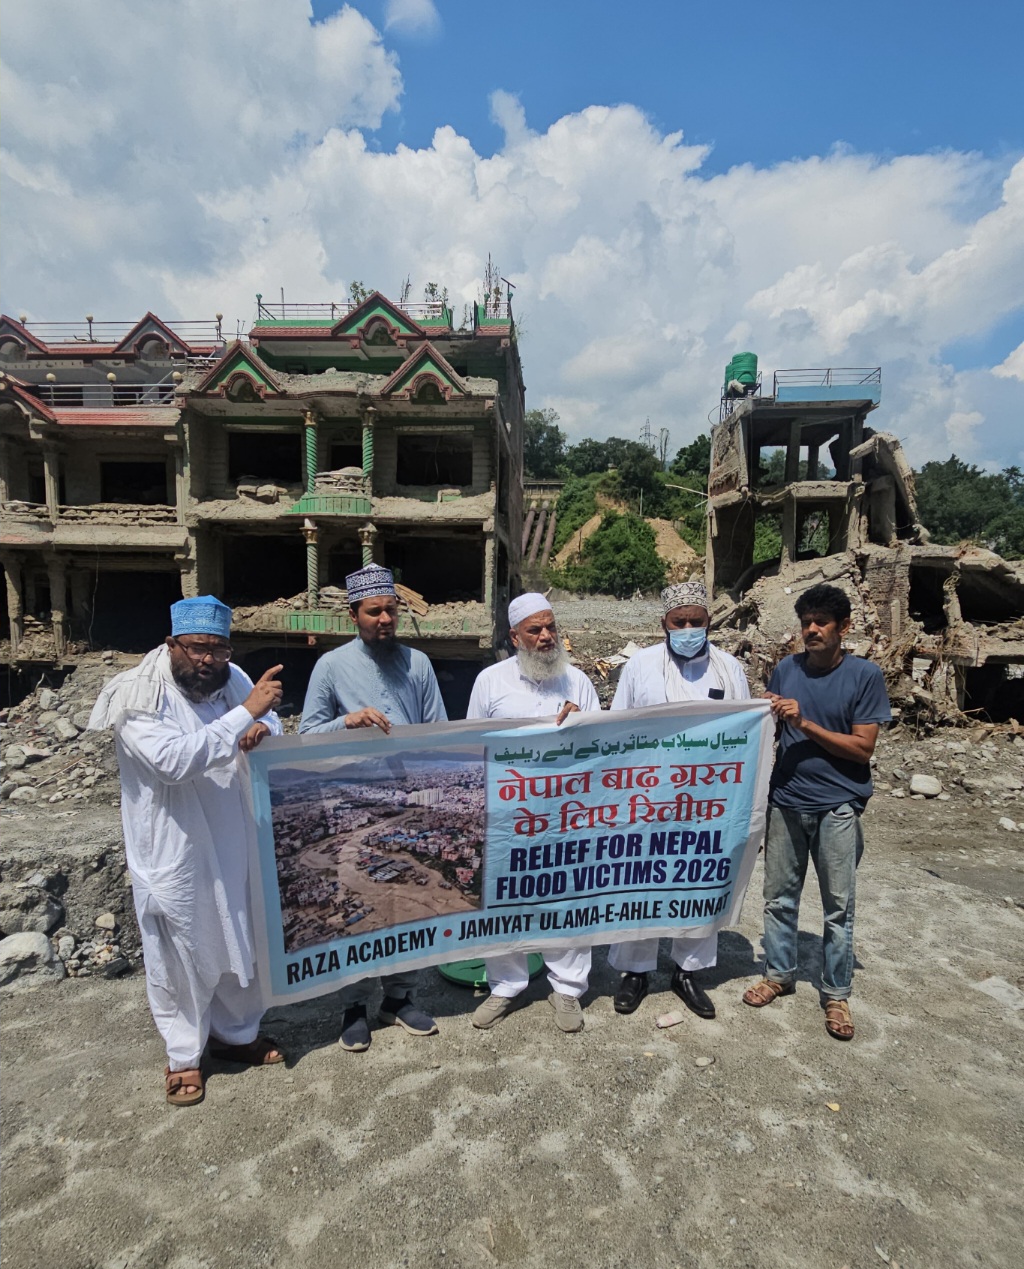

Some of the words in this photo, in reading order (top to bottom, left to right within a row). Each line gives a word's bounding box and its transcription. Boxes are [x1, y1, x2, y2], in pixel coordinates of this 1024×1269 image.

[494, 748, 540, 765] ریلیف
[661, 733, 708, 751] سیلاب
[710, 730, 748, 751] نیپال
[497, 769, 593, 802] नेपाल
[601, 765, 661, 793] बाढ़
[670, 761, 745, 789] ग्रस्त
[513, 807, 550, 836] के
[559, 800, 619, 832] लिए
[628, 792, 727, 824] रिलीफ़
[509, 839, 591, 872] RELIEF
[595, 833, 643, 860] FOR
[649, 830, 723, 857] NEPAL
[496, 870, 567, 900] FLOOD
[573, 859, 667, 892] VICTIMS
[672, 857, 731, 883] 2026
[286, 950, 340, 985] RAZA
[346, 926, 438, 966] ACADEMY
[458, 913, 534, 940] JAMIYAT
[539, 900, 663, 931] ULAMA-E-AHLE
[668, 891, 730, 918] SUNNAT
